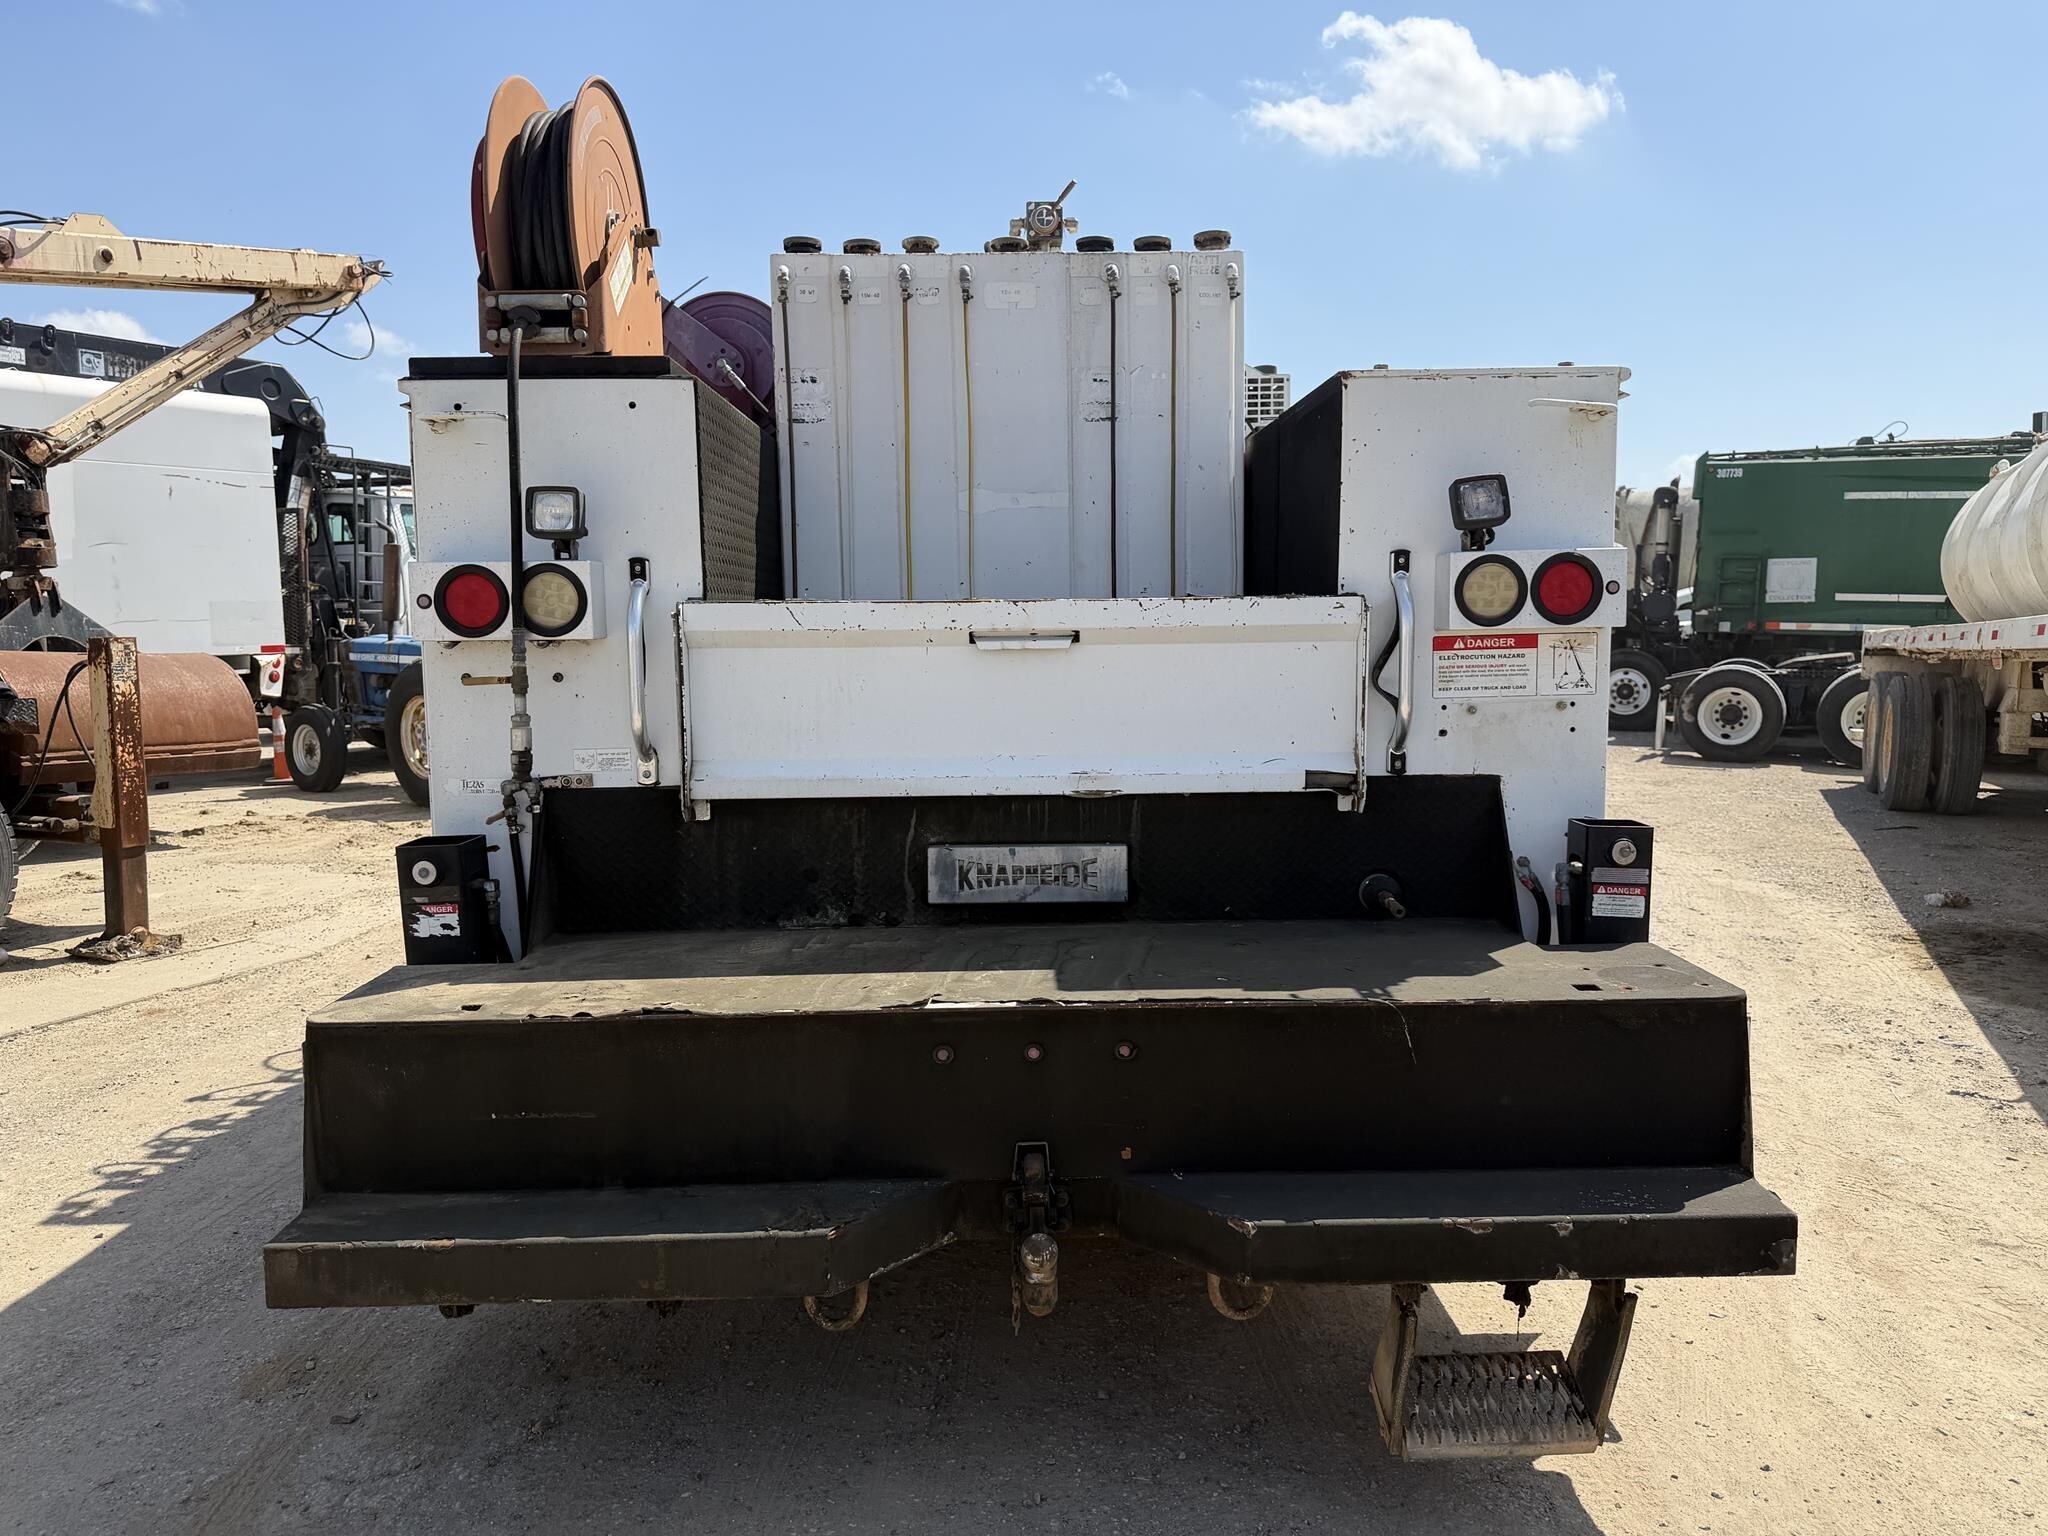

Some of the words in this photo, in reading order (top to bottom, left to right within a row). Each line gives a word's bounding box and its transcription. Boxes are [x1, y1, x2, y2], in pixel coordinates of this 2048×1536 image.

[1466, 638, 1516, 648] DANGER
[1438, 653, 1496, 661] ELECTROCUTION
[957, 856, 1098, 892] KNAPHEIDE
[1606, 887, 1641, 895] DANGER
